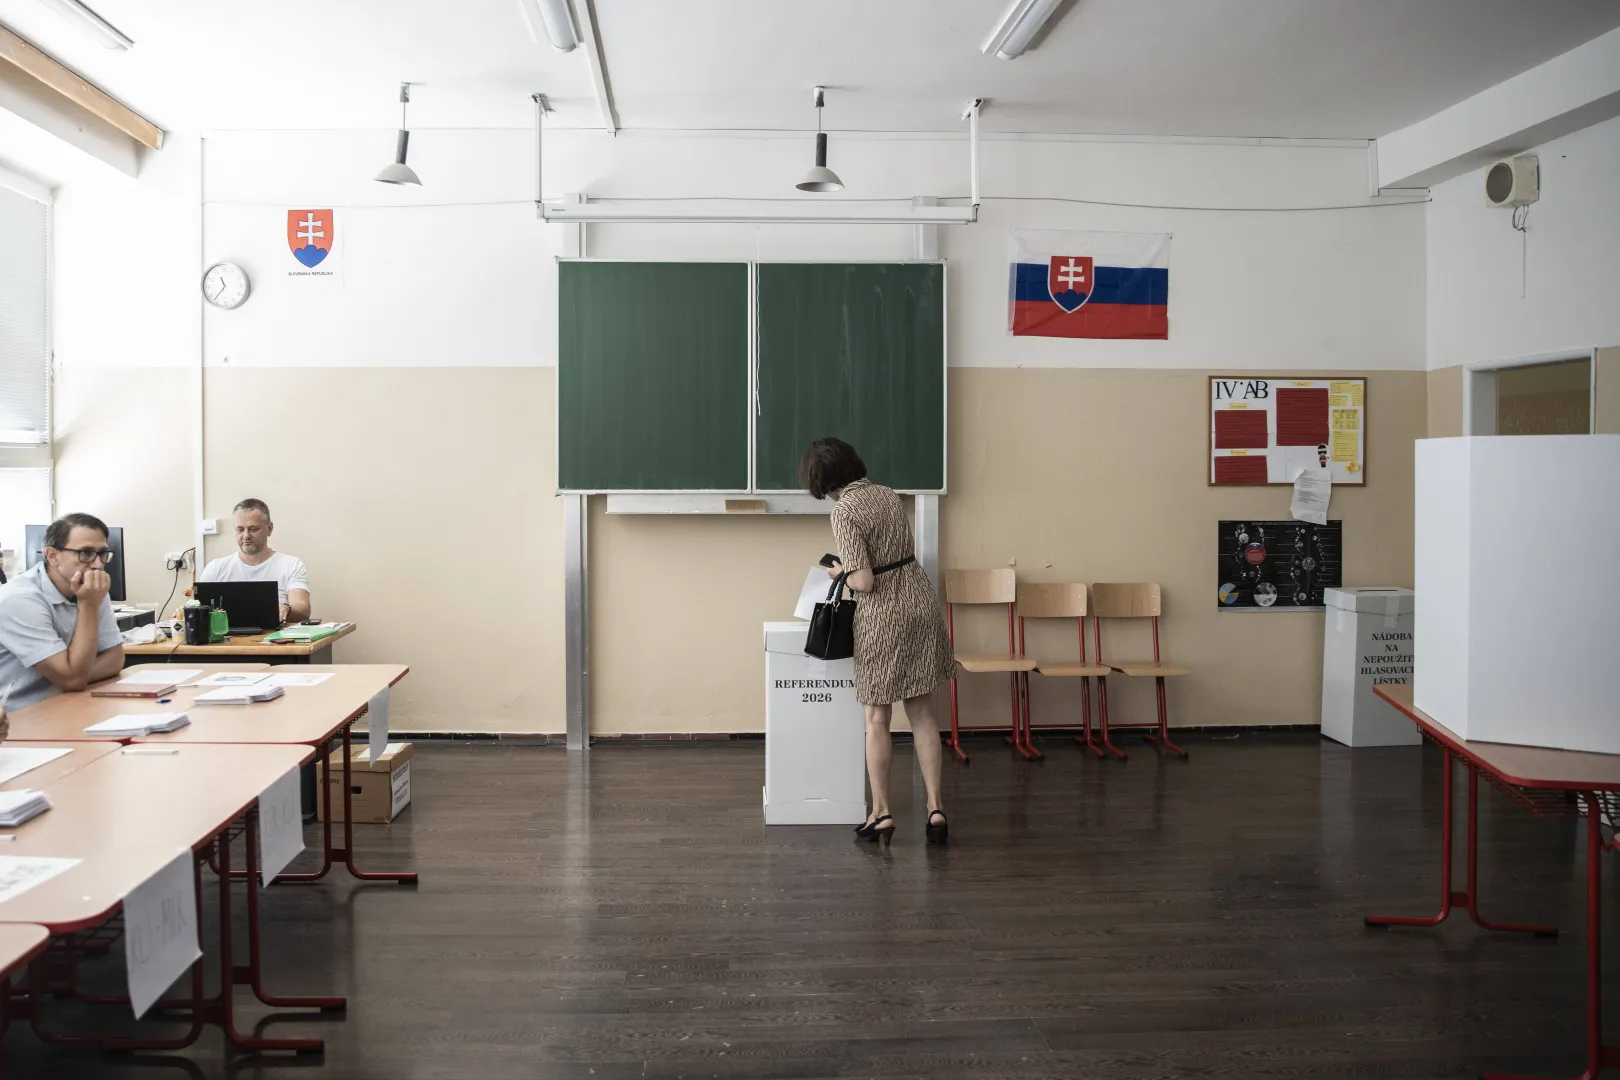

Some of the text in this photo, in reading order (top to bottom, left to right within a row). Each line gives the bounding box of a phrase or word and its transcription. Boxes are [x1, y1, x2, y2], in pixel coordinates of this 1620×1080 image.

[1372, 632, 1412, 640] NÁDOBA
[1363, 654, 1414, 663] NEPOUŽIT
[775, 679, 855, 688] REFERENDUM
[1373, 676, 1407, 685] LÍSTKY
[802, 693, 832, 702] 2026
